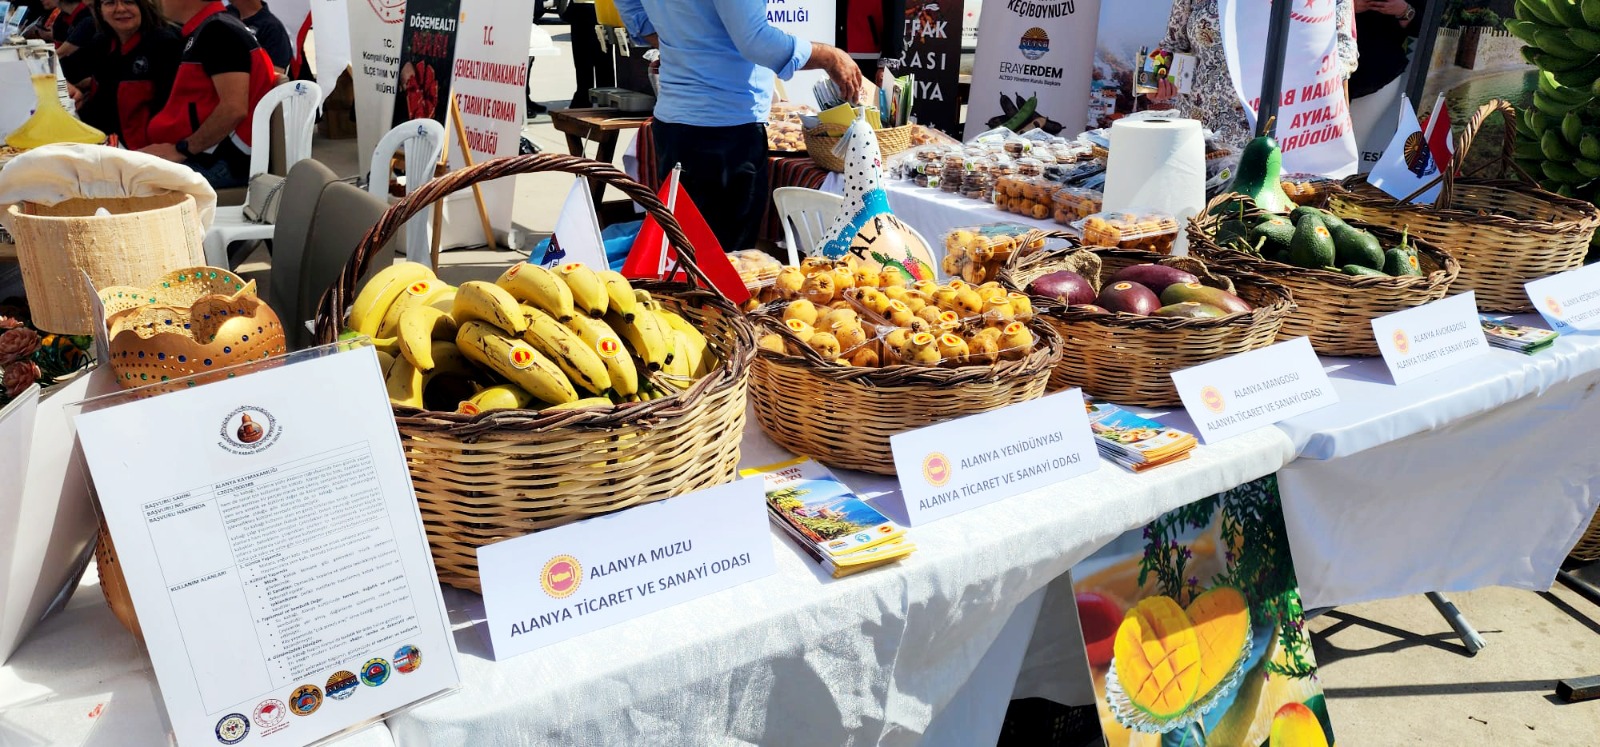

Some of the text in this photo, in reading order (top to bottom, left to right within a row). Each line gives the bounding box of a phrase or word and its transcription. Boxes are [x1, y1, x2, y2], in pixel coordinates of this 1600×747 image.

[410, 13, 456, 31] DÖŞEMEALTI
[1007, 0, 1075, 18] KEÇİBOYNUZU
[483, 26, 494, 45] T.C.
[481, 62, 526, 86] KAYMAKAMLIĞI
[463, 95, 483, 116] TARIM
[483, 98, 491, 118] VE
[491, 100, 516, 123] ORMAN
[457, 126, 498, 155] ÜDÜRLÜĞÜ
[1414, 331, 1435, 343] ALANYA
[1396, 357, 1418, 370] ALANYA
[1234, 372, 1300, 400] ALANYA MANGOSU
[1207, 387, 1323, 431] ALANYA TİCARET VE SANAYİ ODASI
[960, 431, 1063, 470] ALANYA YENİDÜNYASI
[919, 453, 1081, 511] ALANYA TİCARET VE SANAYİ ODASI
[590, 539, 692, 580] ALANYA MUZU
[510, 552, 751, 637] ALANYA TİCARET VE SANAYİ ODASI
